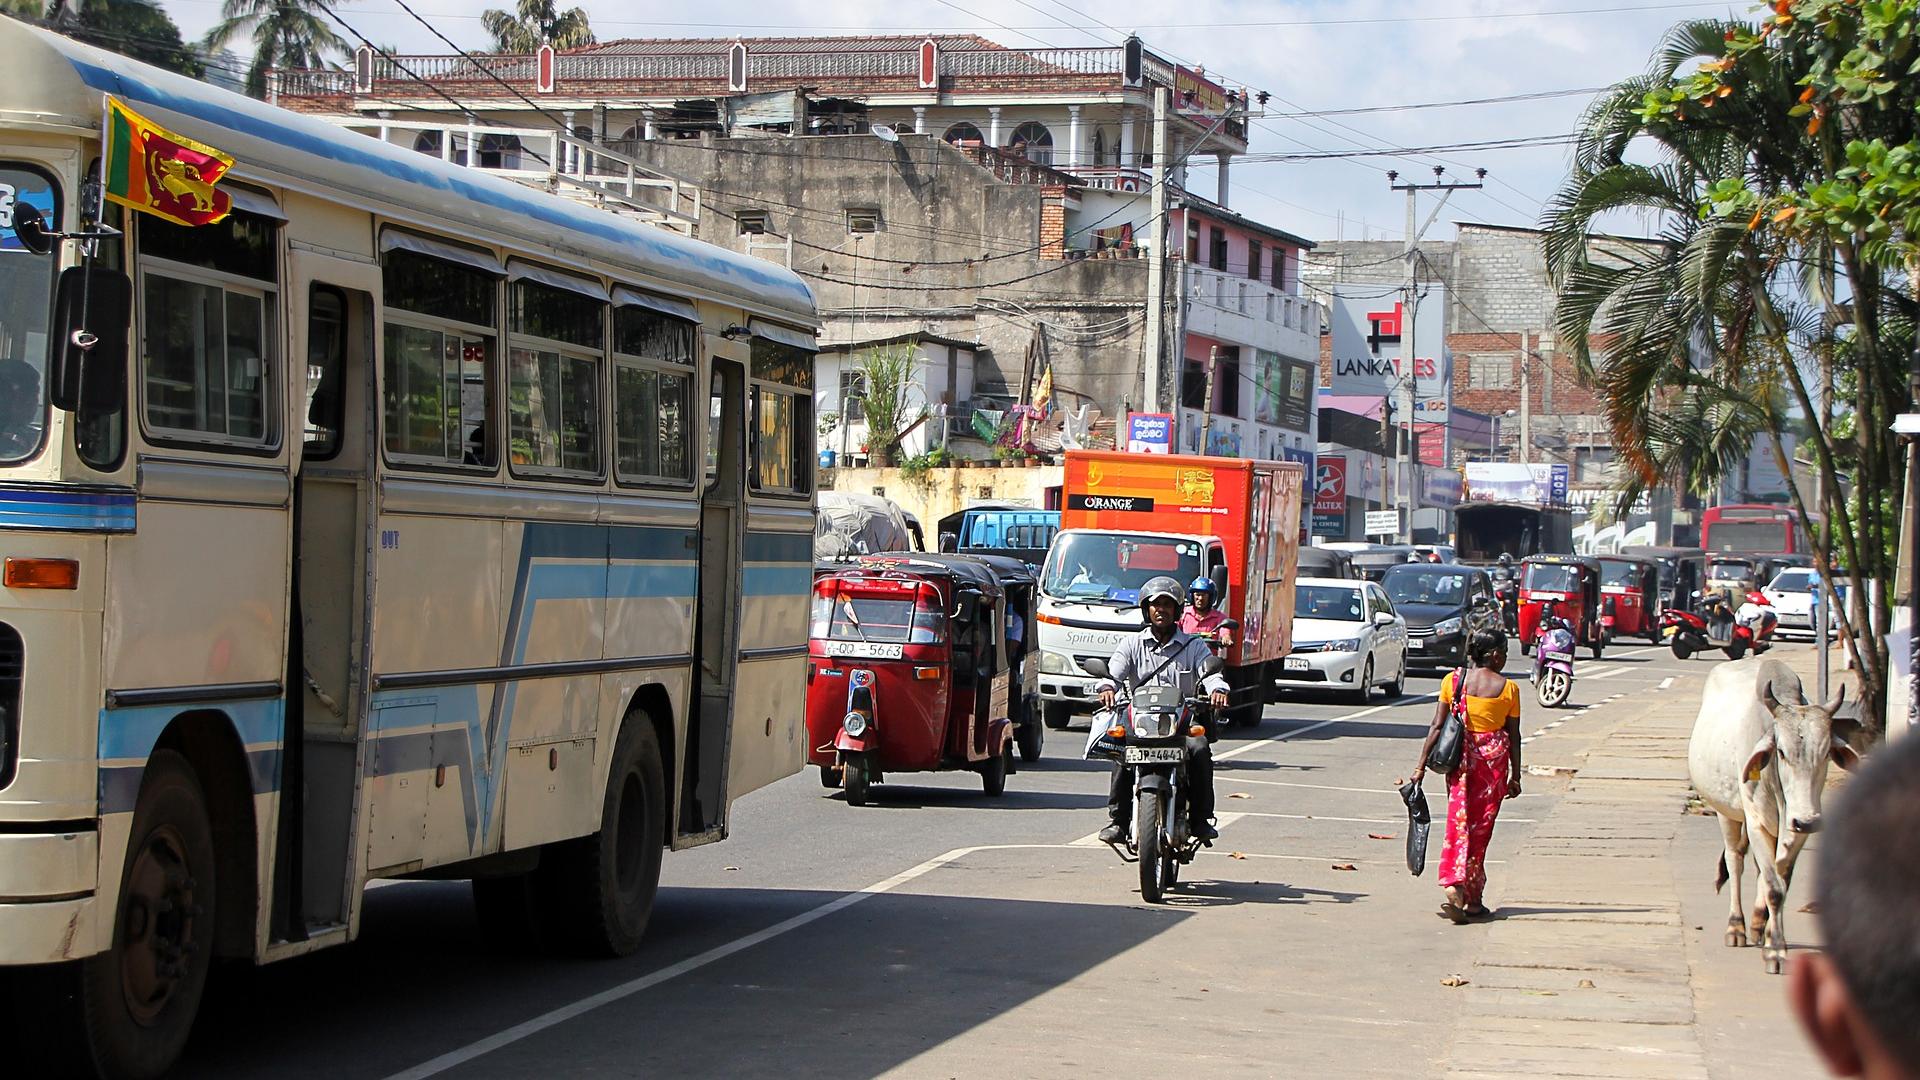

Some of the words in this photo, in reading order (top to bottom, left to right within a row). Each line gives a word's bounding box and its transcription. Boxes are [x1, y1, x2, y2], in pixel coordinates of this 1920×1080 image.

[1336, 358, 1436, 378] LANKATES
[1427, 400, 1447, 411] IOC
[1084, 496, 1133, 508] ORANGE
[1313, 502, 1342, 510] ALTEX
[381, 530, 400, 549] OUT
[1066, 631, 1094, 645] Spirit
[1097, 633, 1111, 645] of
